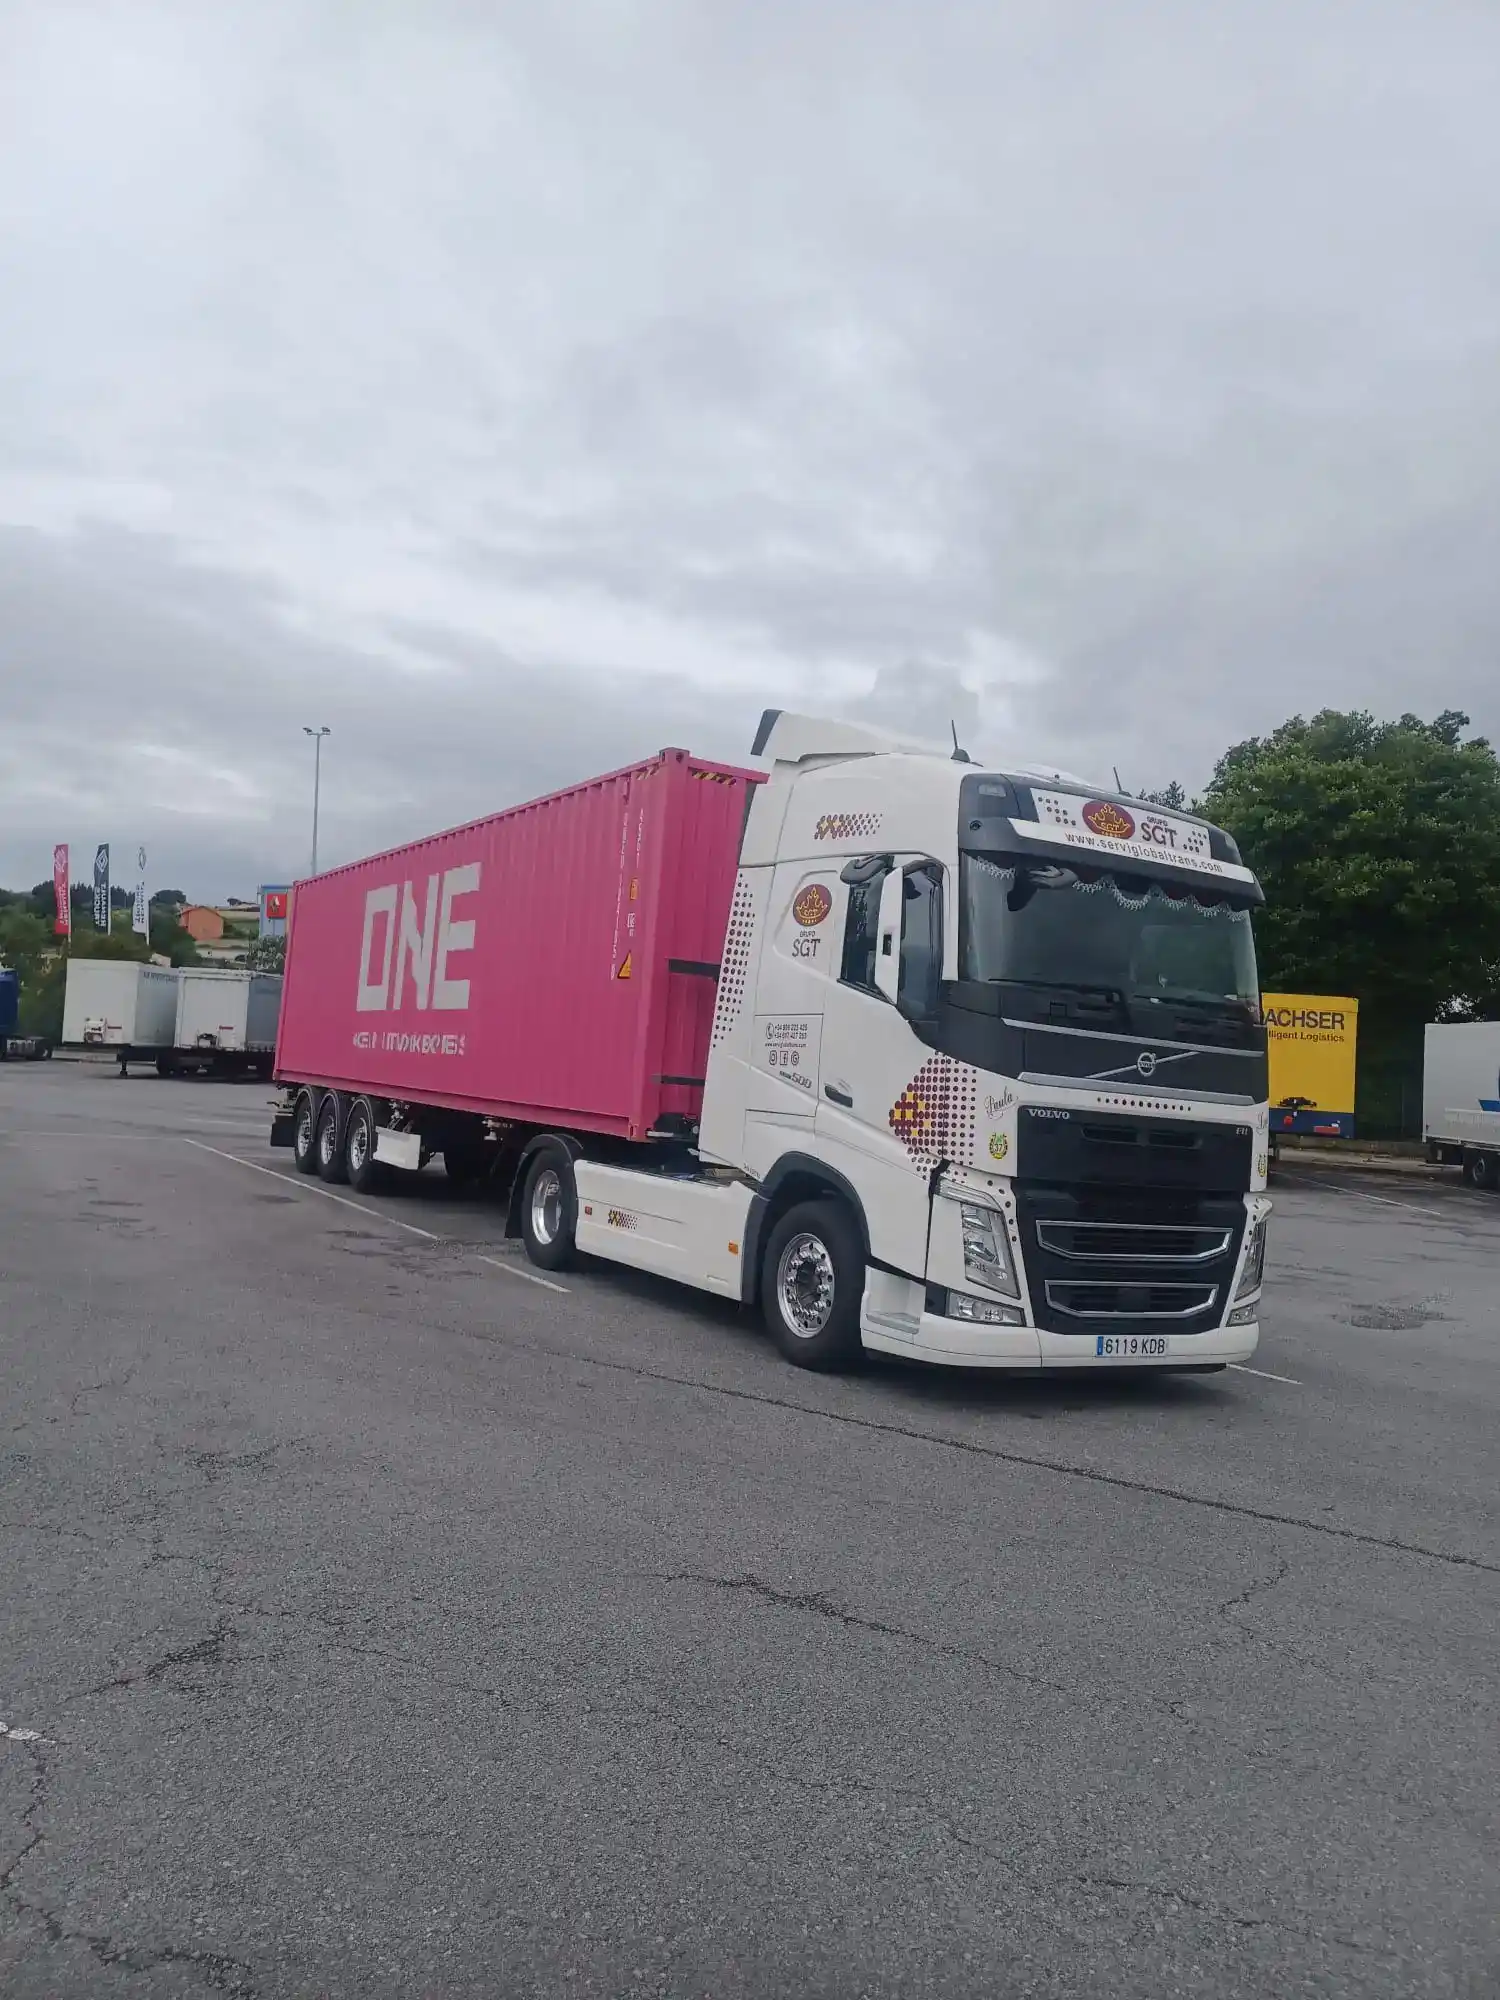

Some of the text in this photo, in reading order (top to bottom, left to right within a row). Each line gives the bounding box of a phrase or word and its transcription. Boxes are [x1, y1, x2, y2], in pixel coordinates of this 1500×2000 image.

[1146, 816, 1168, 826] GRUPO
[1141, 822, 1178, 848] SGT
[1065, 832, 1223, 873] www.serviglobaltrans.com
[357, 862, 482, 1011] ONE
[792, 938, 821, 957] SGT
[1263, 1008, 1345, 1030] ACHSER
[1268, 1030, 1345, 1042] lligent Logistics
[792, 1073, 812, 1088] 500
[1028, 1109, 1070, 1120] VOLVO
[1105, 1338, 1165, 1354] 6119 KDB
